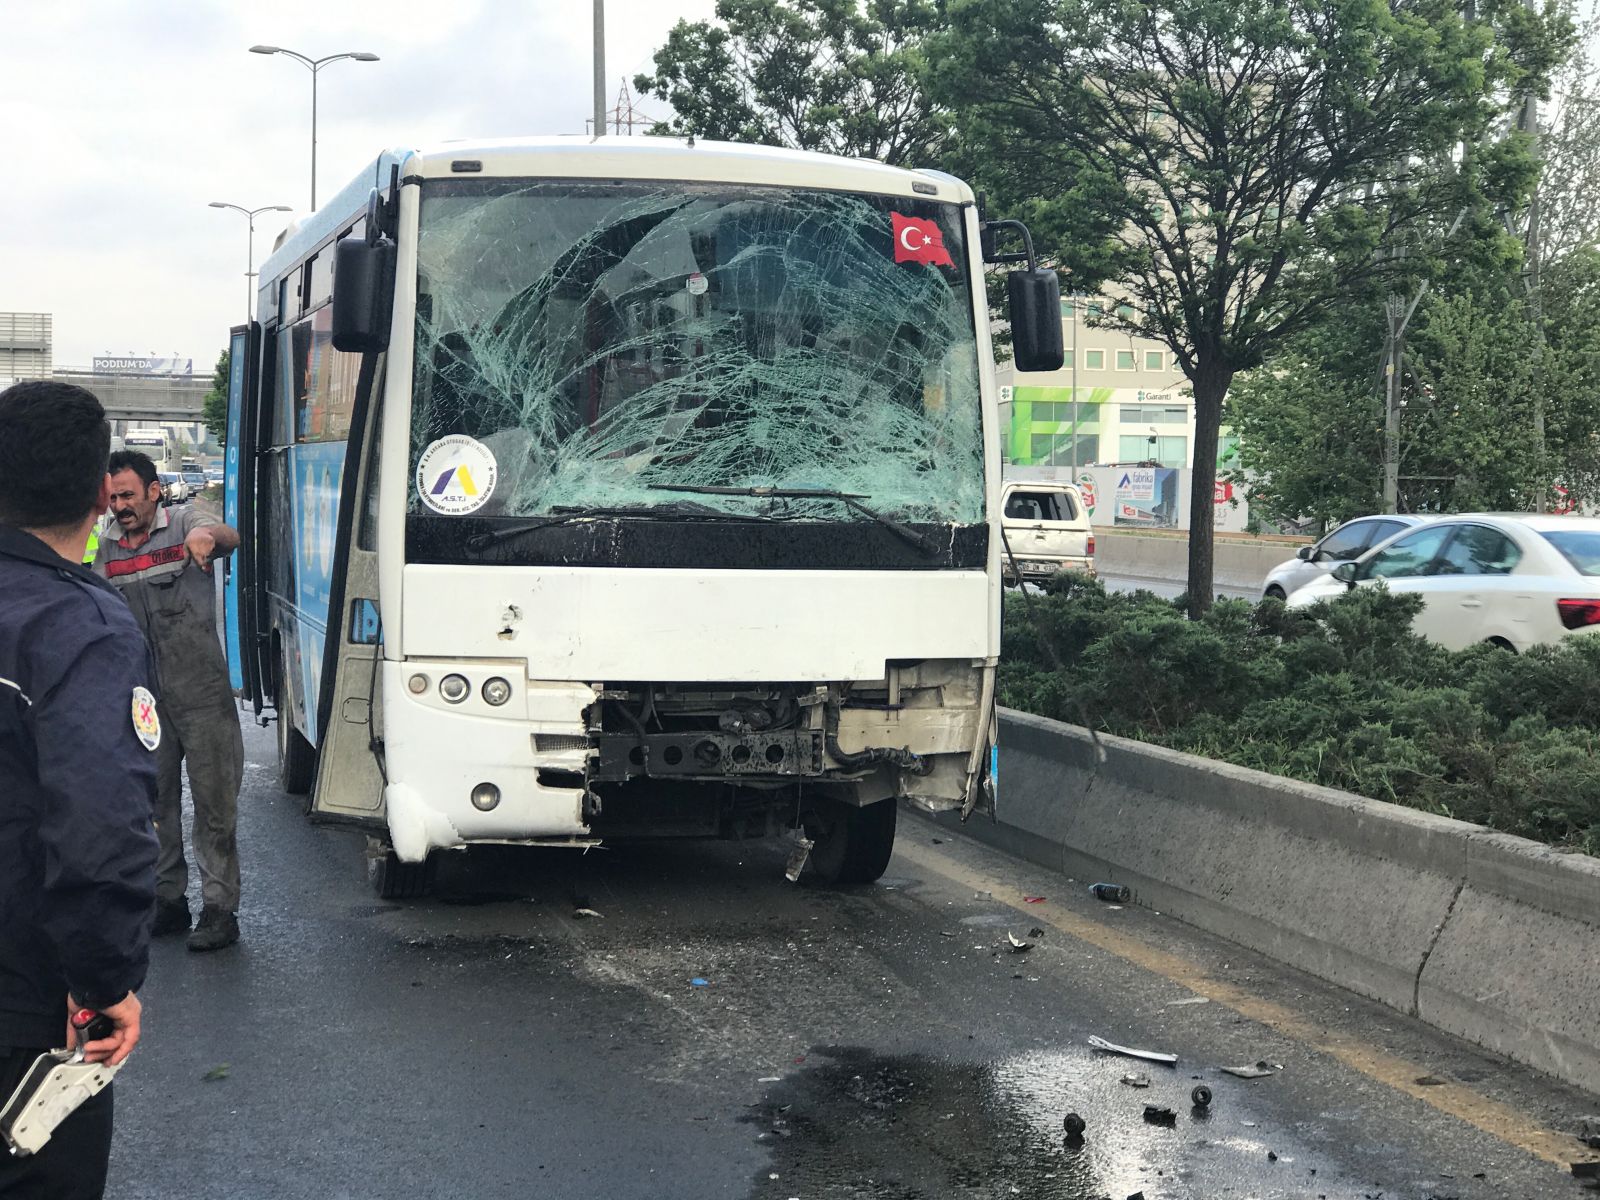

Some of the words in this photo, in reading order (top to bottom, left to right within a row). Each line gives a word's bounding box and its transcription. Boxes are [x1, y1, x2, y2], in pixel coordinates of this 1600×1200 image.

[95, 360, 153, 369] PODIUM'DA
[1145, 392, 1171, 400] Garanti
[1133, 471, 1153, 483] fabrika
